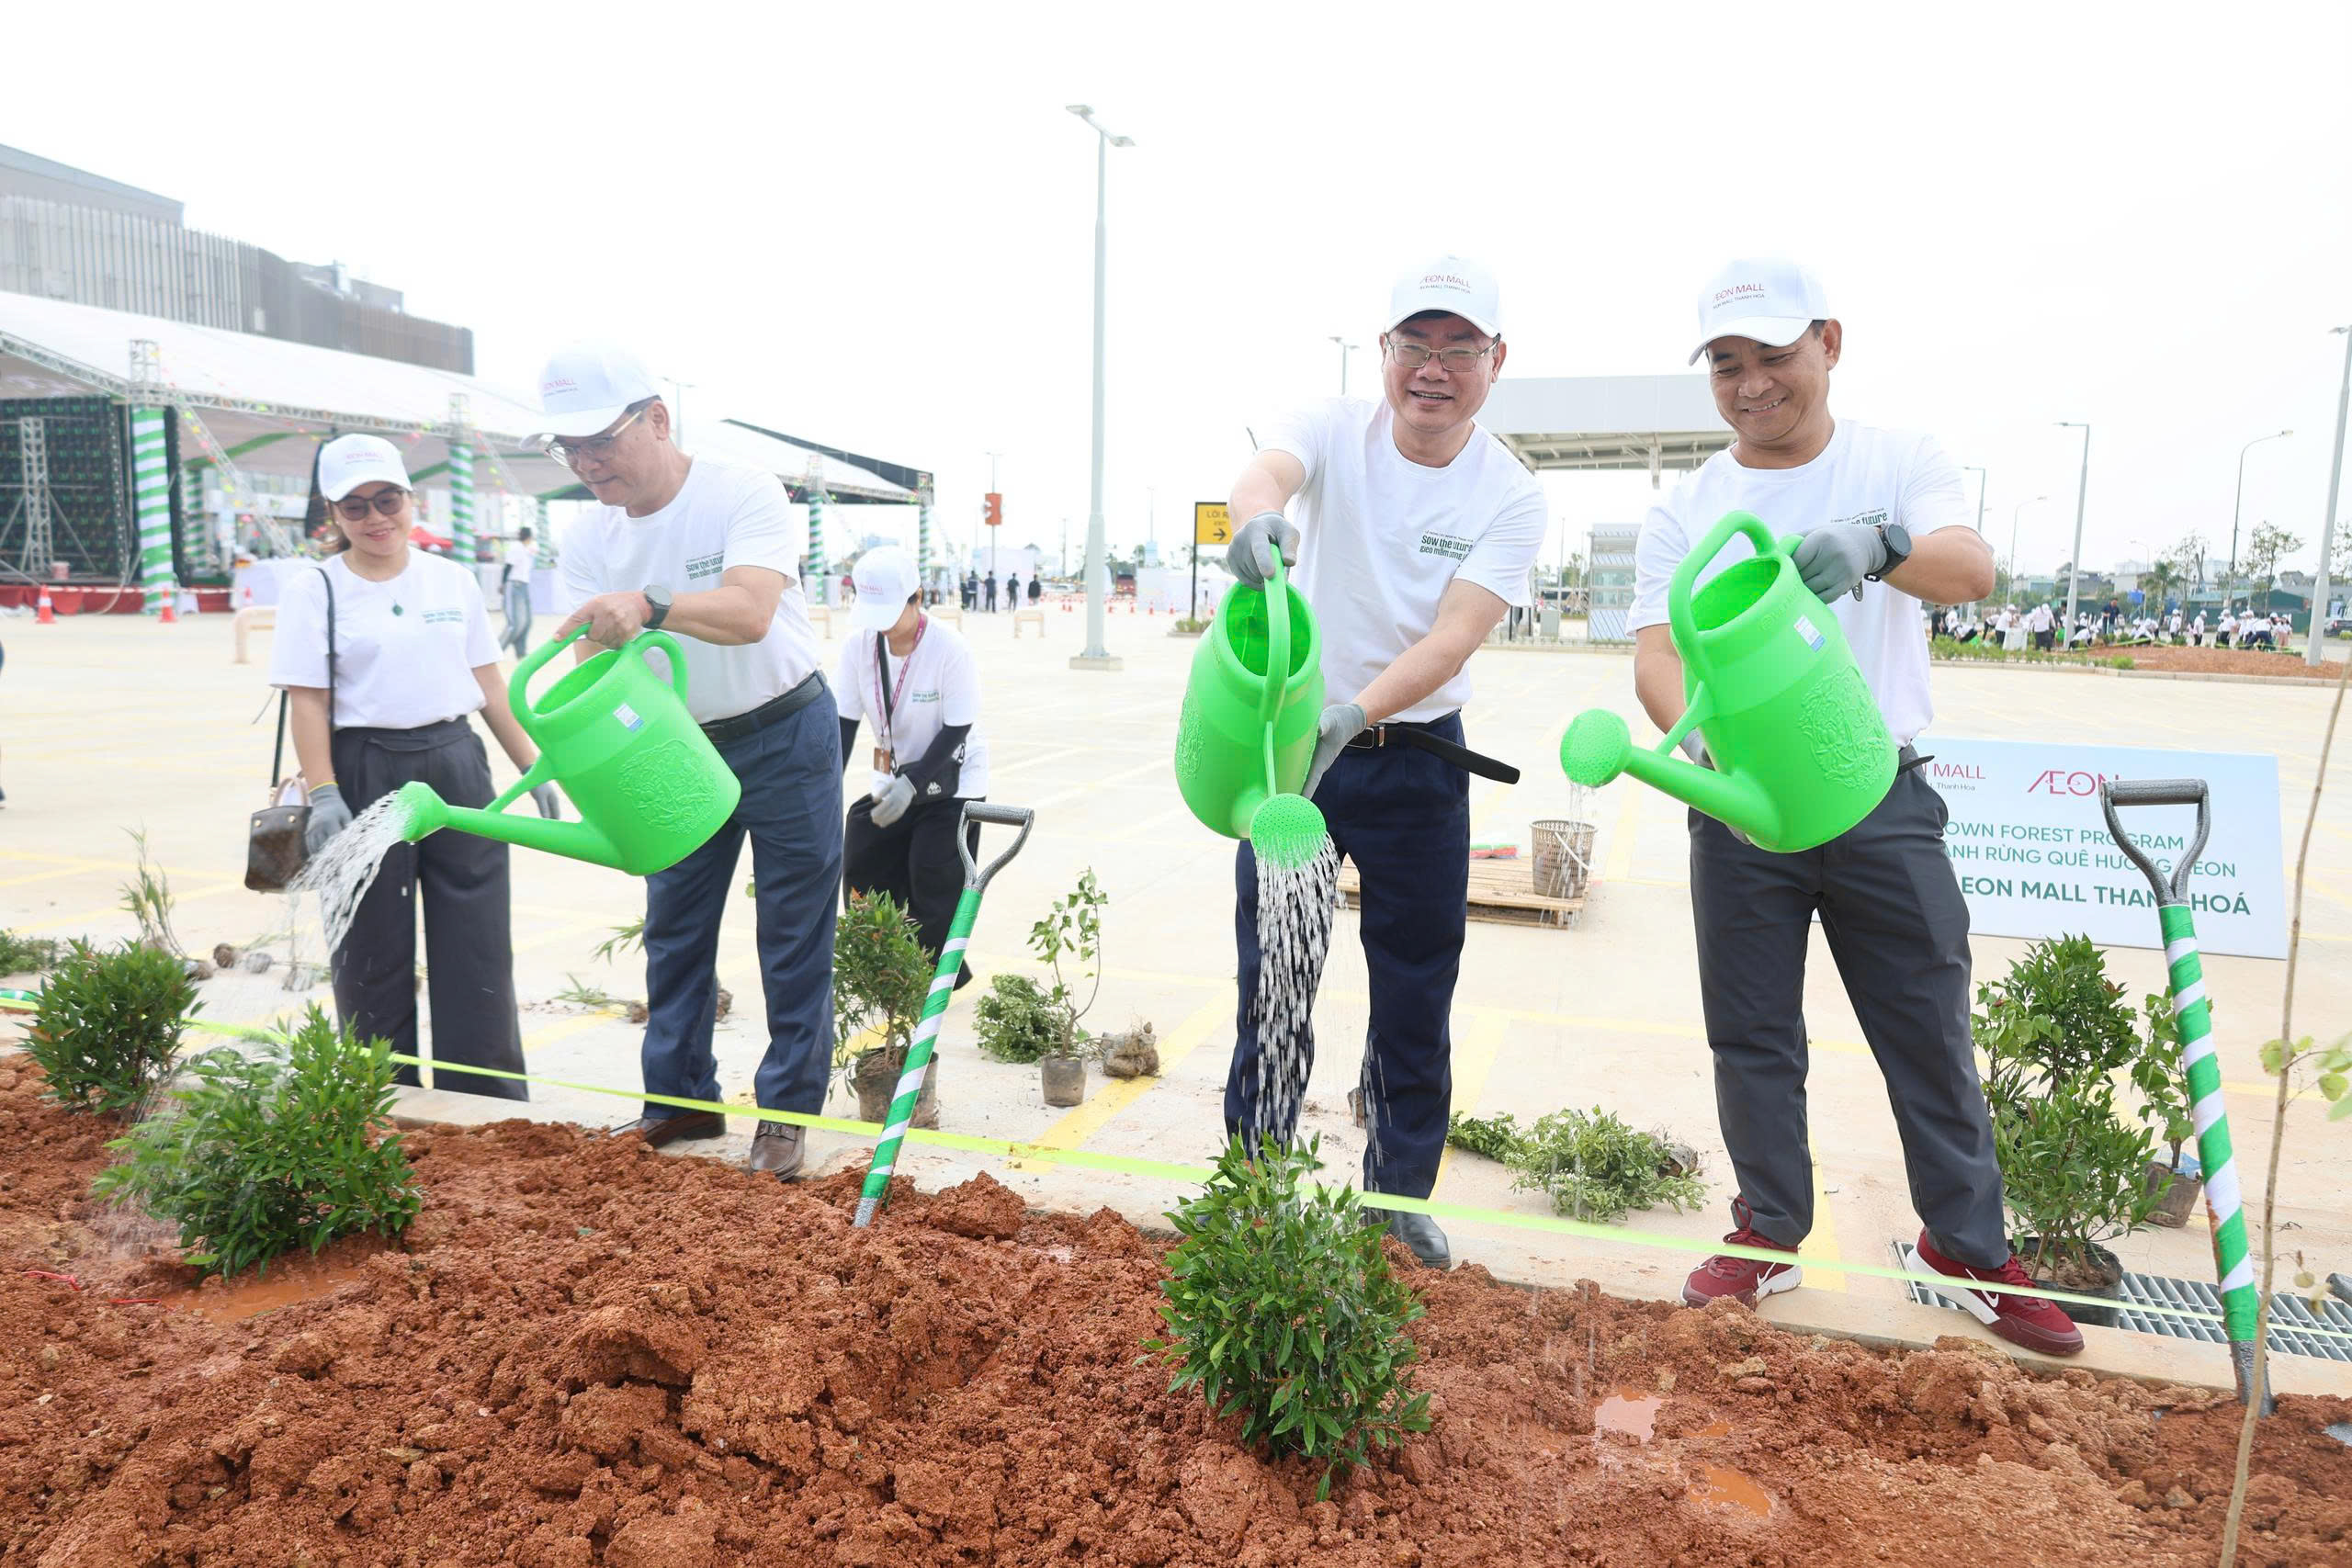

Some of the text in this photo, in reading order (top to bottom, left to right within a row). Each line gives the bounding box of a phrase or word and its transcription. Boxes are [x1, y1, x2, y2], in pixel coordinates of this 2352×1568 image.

[1446, 275, 1471, 288] MALL
[1736, 283, 1764, 294] MALL
[1861, 512, 1888, 525] future
[1421, 535, 1440, 547] Sow
[1440, 538, 1453, 549] the
[1934, 763, 1986, 780] MALL
[1937, 782, 1959, 790] Thanh
[1945, 821, 1995, 839] OWN
[2001, 825, 2074, 843] FOREST
[1985, 843, 2041, 864] RỪNG
[2048, 849, 2089, 868] QUÊ
[2193, 860, 2235, 878] EON
[1962, 876, 2252, 916] EON MALL THAN HOÁ
